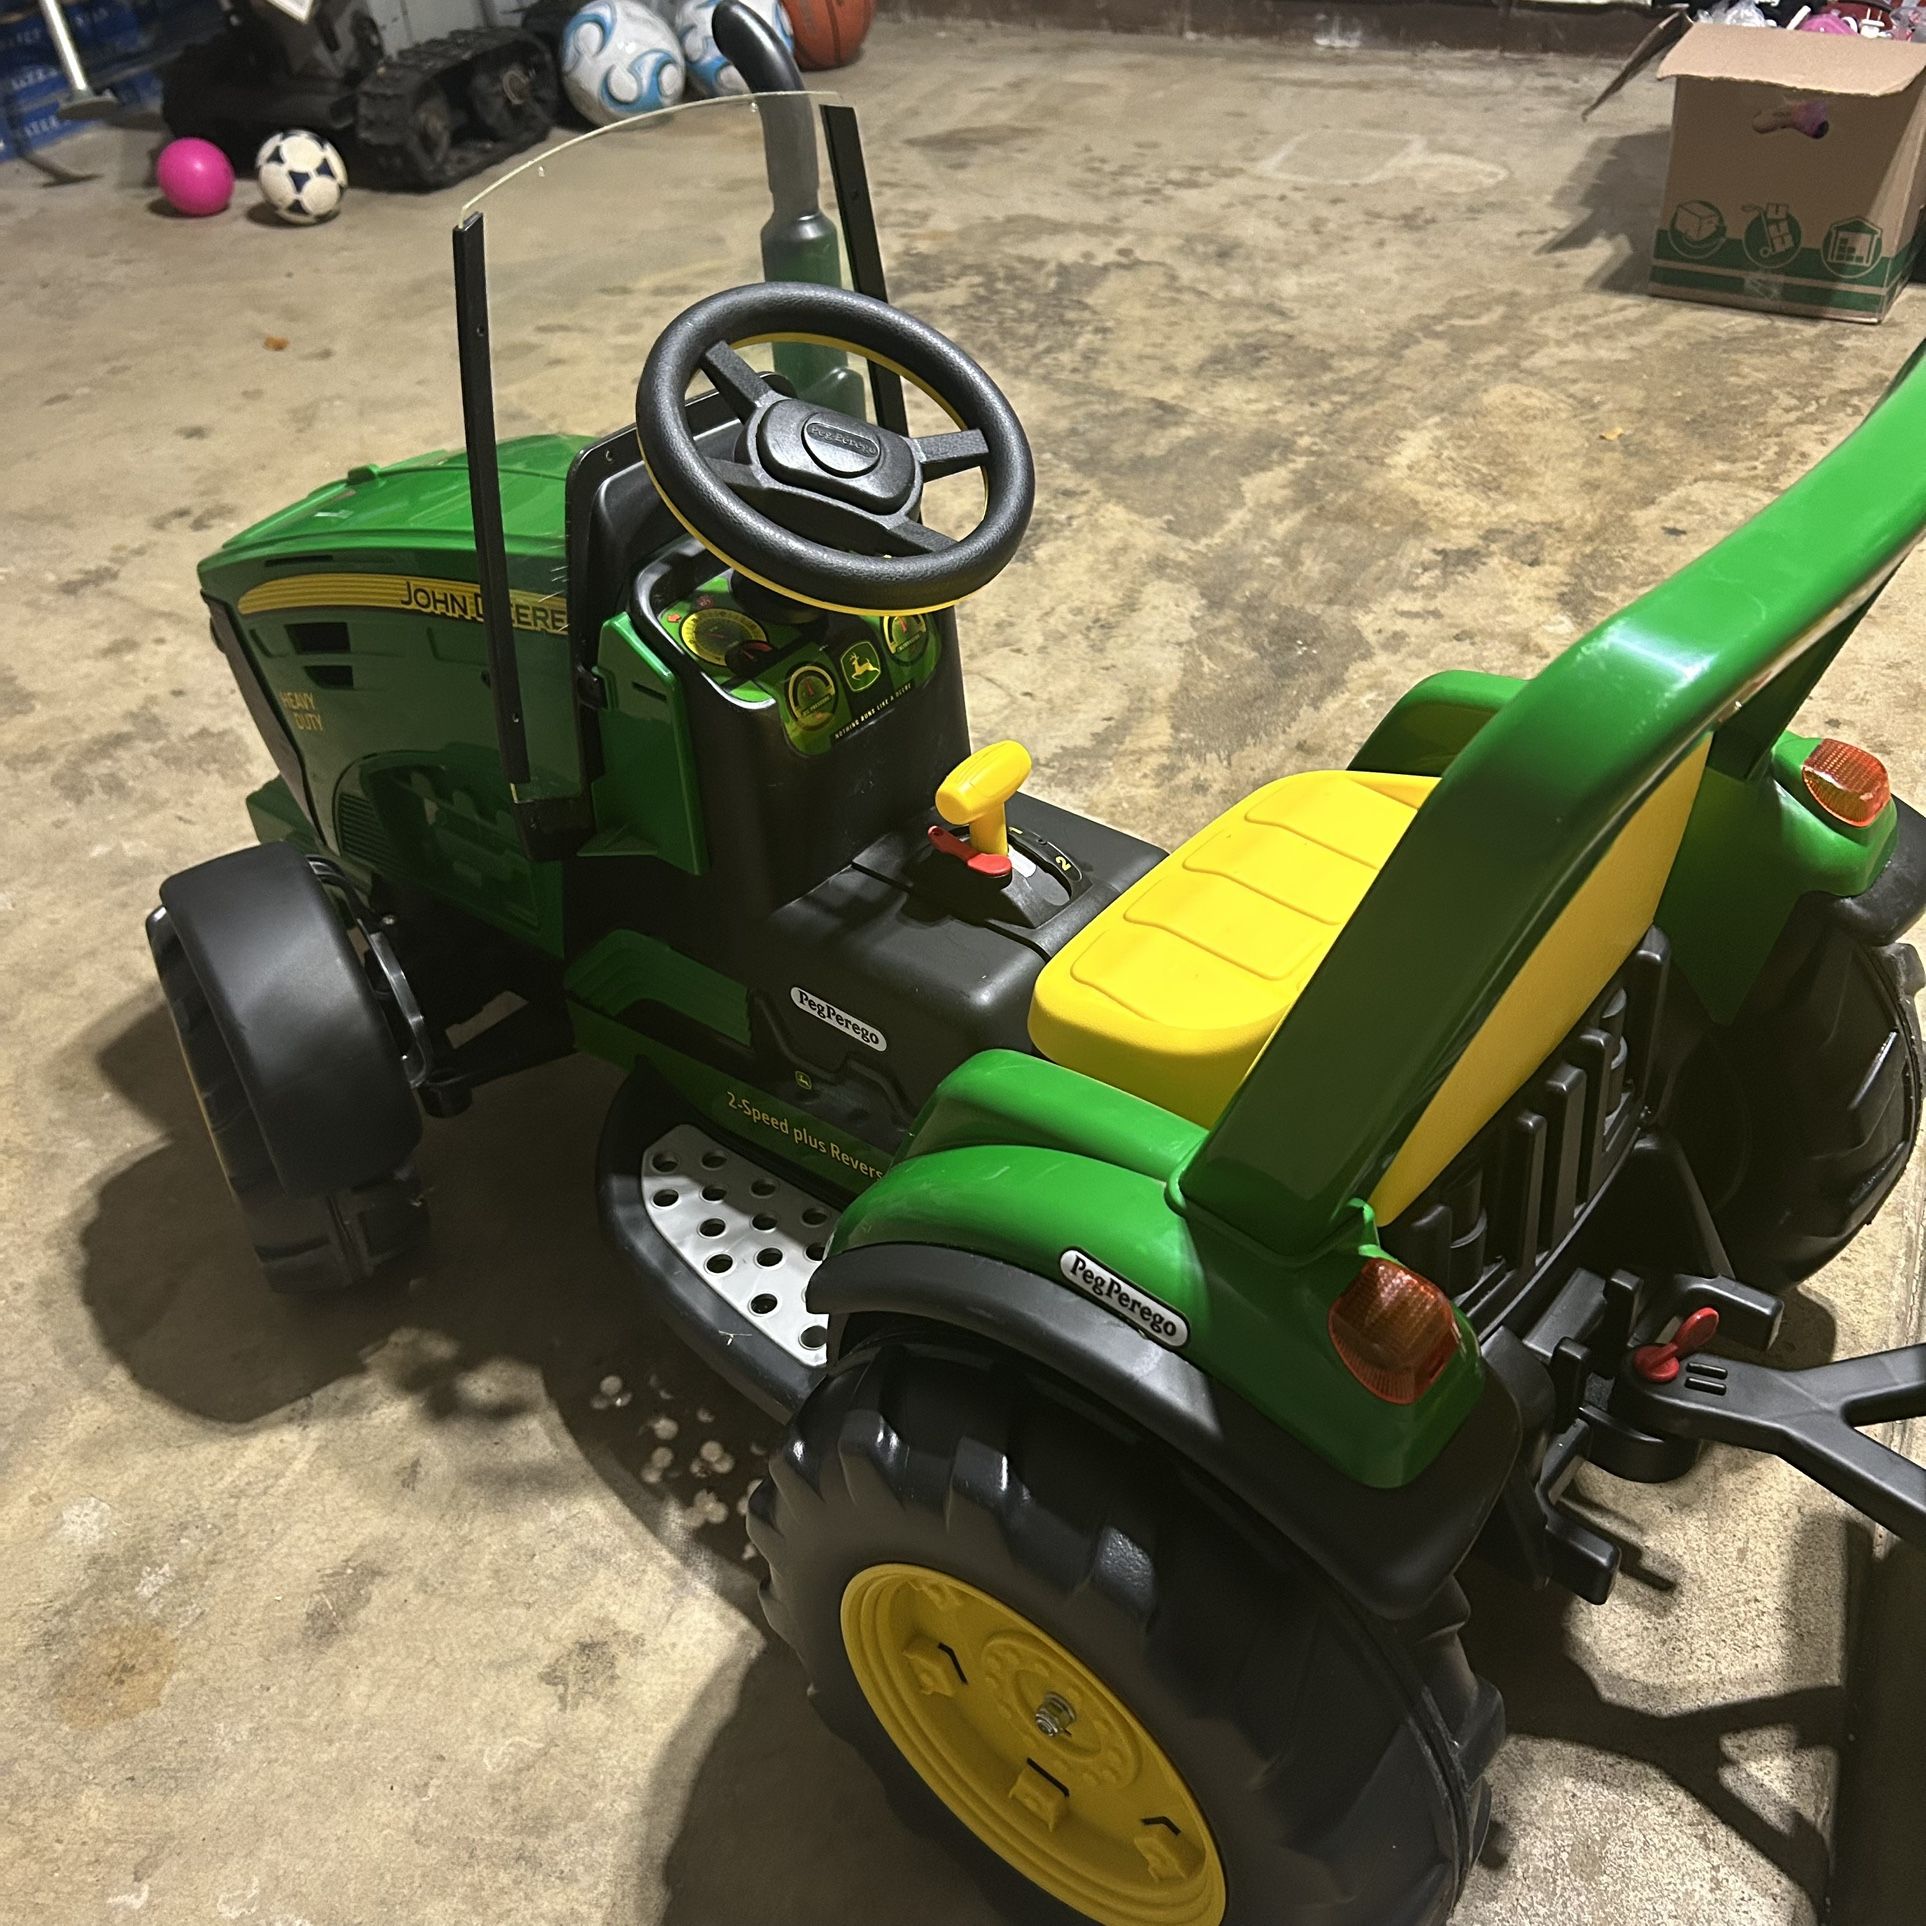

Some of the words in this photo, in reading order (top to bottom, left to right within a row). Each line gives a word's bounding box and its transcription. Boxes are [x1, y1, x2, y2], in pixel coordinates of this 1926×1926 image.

[401, 580, 468, 617] JOHN
[474, 592, 568, 632] DERE
[279, 690, 316, 711] HEAVY
[293, 712, 324, 732] DUTY
[1055, 856, 1071, 871] 2
[798, 989, 880, 1046] PegPerego
[727, 1091, 789, 1135] 2-Speed
[793, 1126, 827, 1154] plus
[830, 1142, 883, 1181] Revers
[1070, 1254, 1177, 1337] PegPerego
